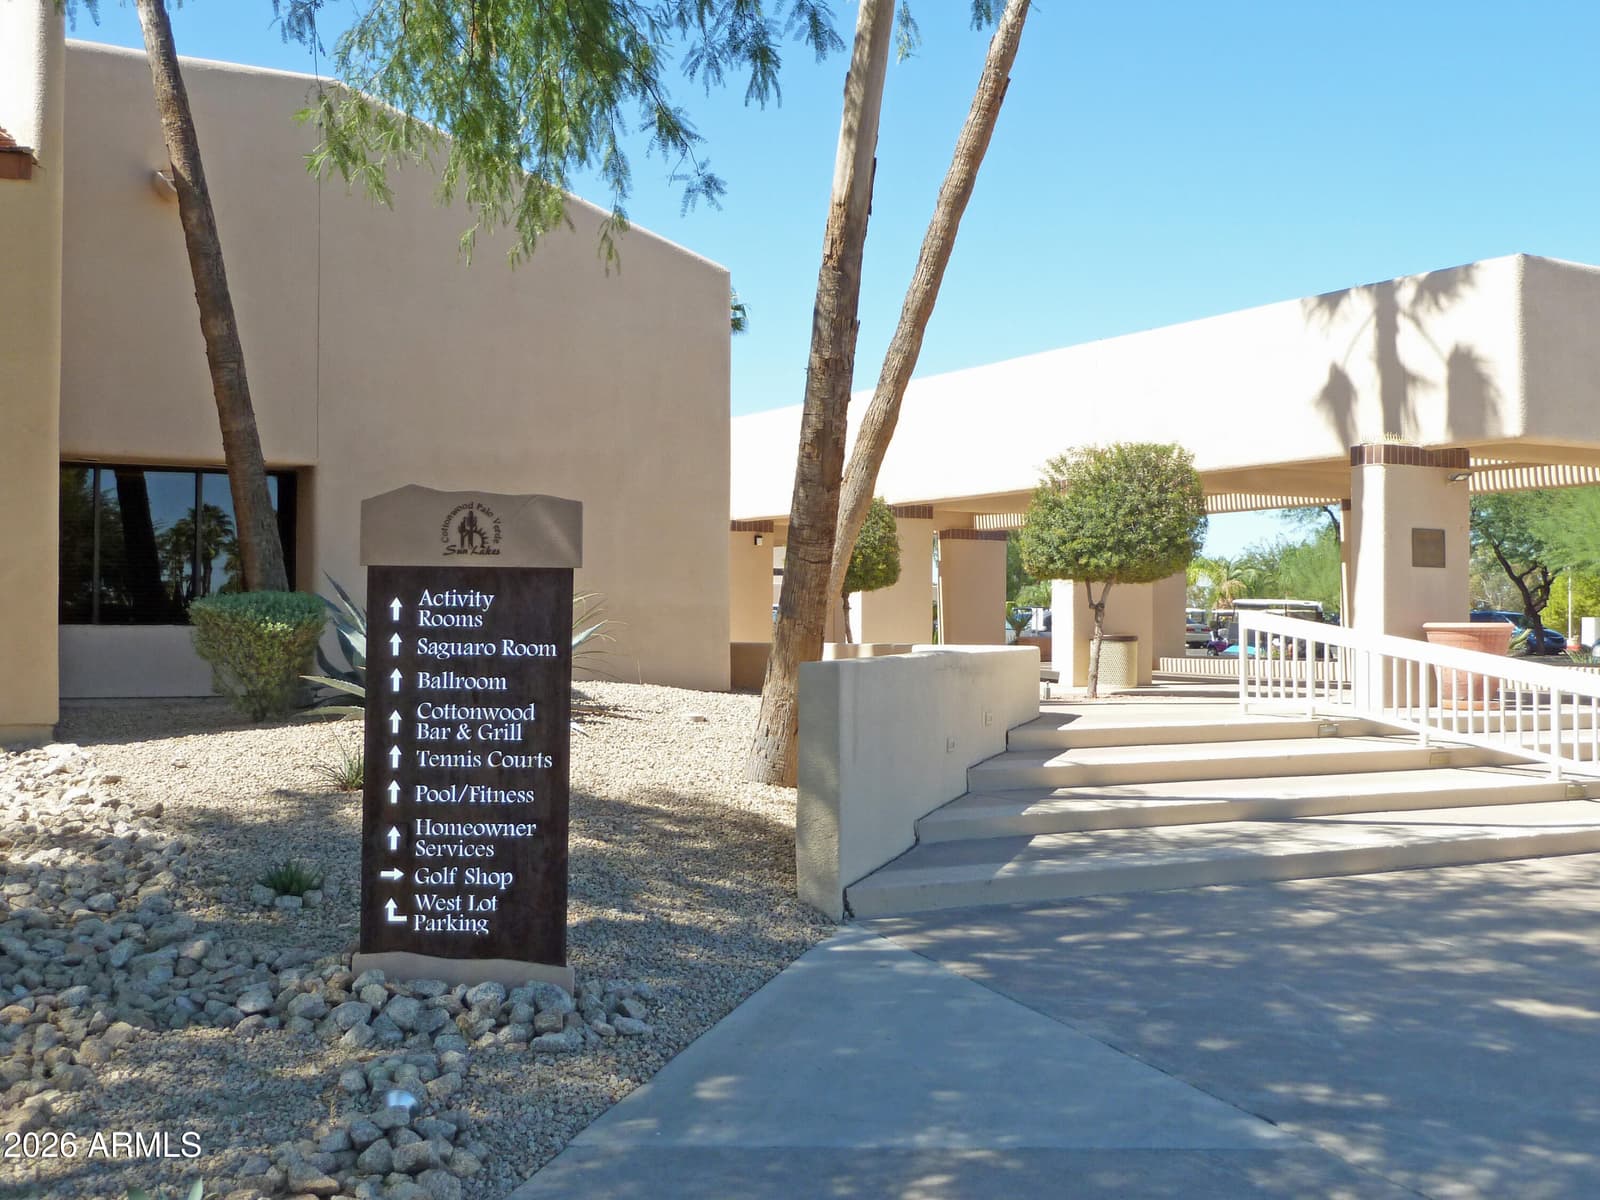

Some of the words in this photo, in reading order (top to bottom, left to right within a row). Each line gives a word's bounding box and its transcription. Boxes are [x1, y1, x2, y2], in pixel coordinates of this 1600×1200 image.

[440, 501, 474, 544] Cottonwood
[477, 502, 494, 518] Palo
[493, 517, 502, 544] Verde
[442, 544, 468, 556] Sun
[470, 545, 501, 556] Lakes
[418, 588, 494, 612] Activity
[418, 609, 484, 628] Rooms
[416, 637, 497, 660] Saguaro
[501, 639, 558, 657] Room
[417, 671, 508, 690] Ballroom
[416, 702, 536, 721] Cottonwood
[416, 722, 451, 741] Bar
[456, 722, 472, 741] &
[478, 722, 523, 741] Grill
[416, 749, 482, 768] Tennis
[487, 750, 553, 769] Courts
[415, 783, 535, 804] Pool/Fitness
[415, 818, 537, 837] Homeowner
[415, 839, 495, 858] Services
[414, 866, 458, 885] Golf
[464, 866, 514, 890] Shop
[414, 893, 463, 912] West
[467, 894, 499, 912] Lot
[413, 913, 489, 936] Parking
